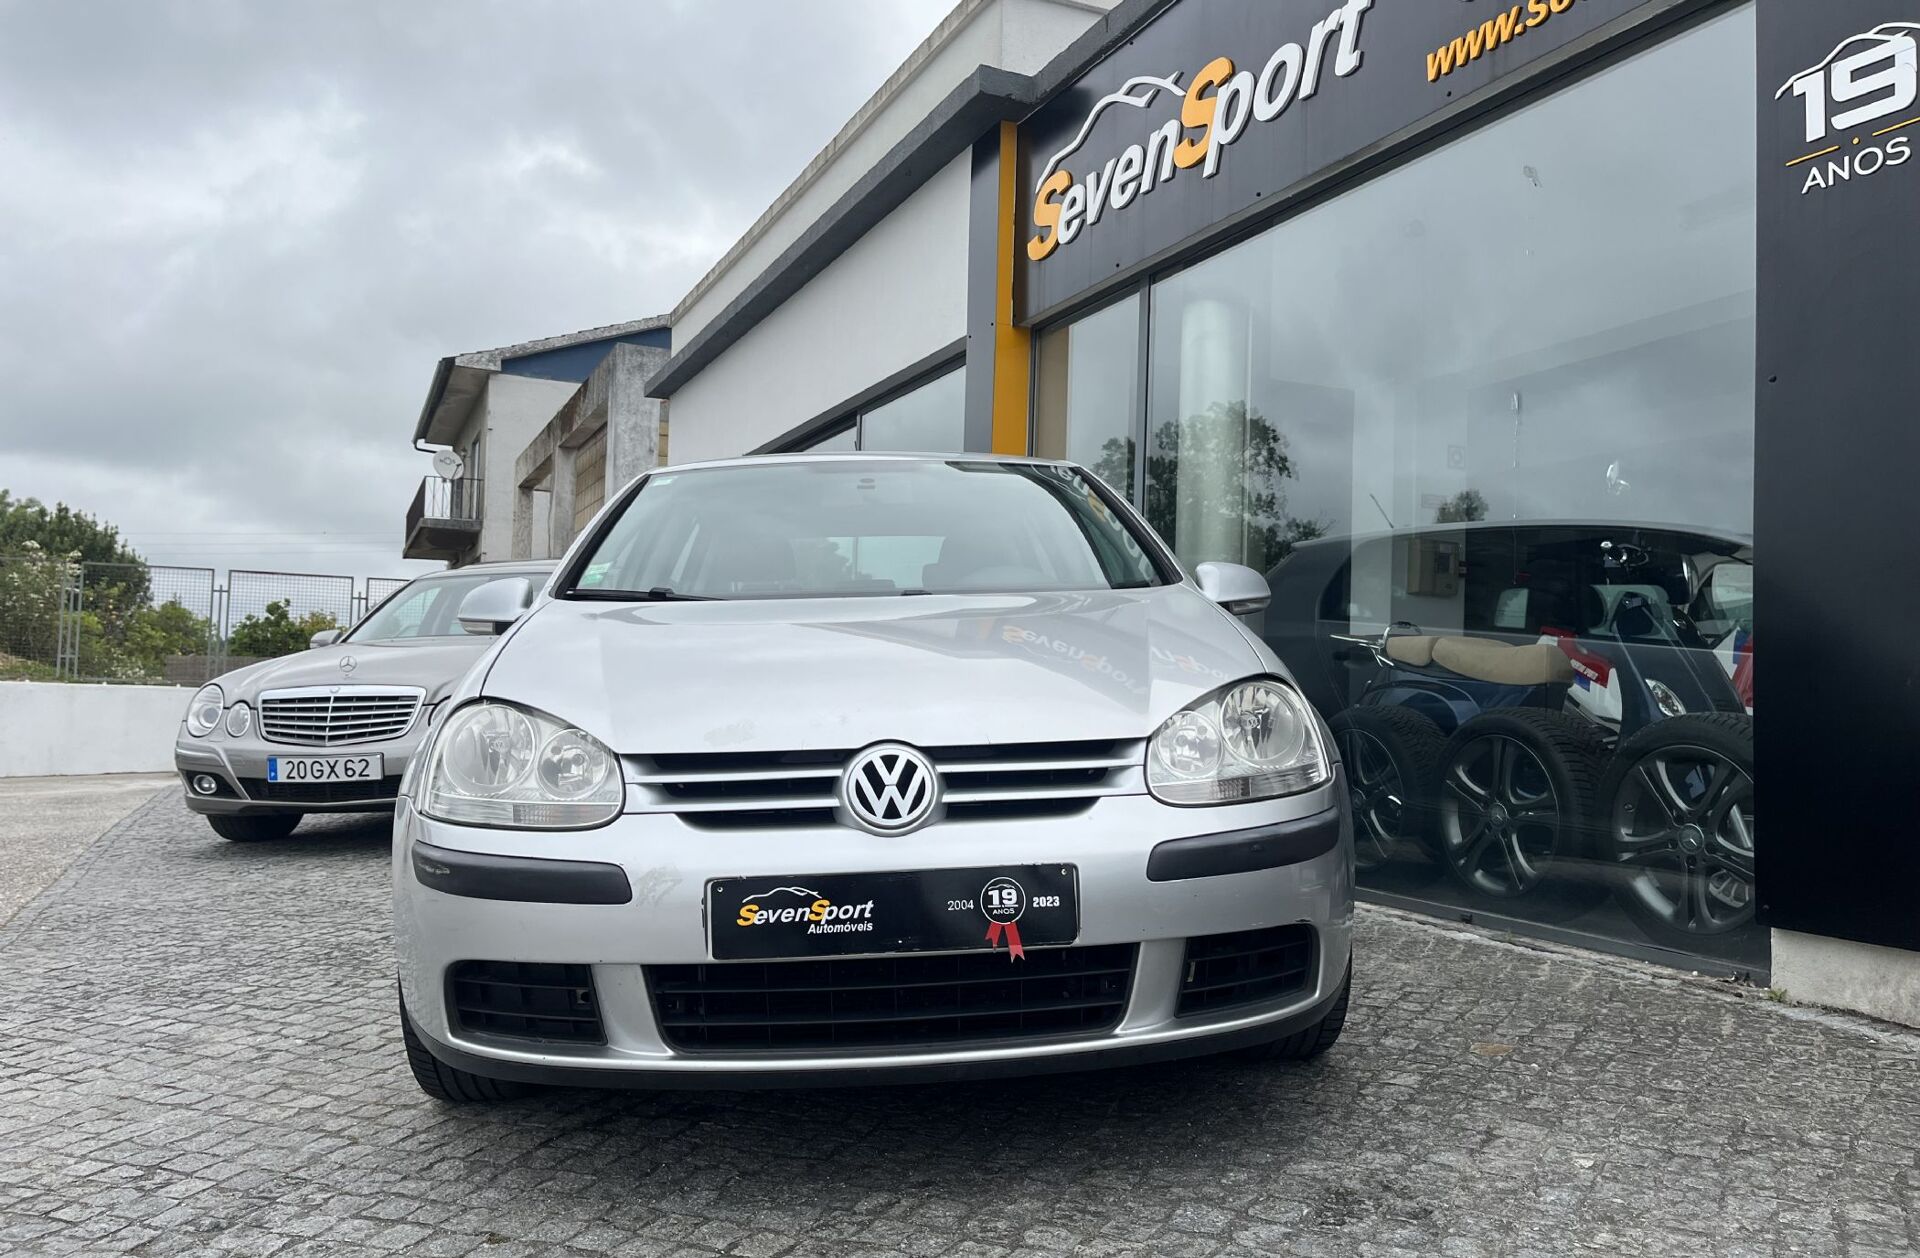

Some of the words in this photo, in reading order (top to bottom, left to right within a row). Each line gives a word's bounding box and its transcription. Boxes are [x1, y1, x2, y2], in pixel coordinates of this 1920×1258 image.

[1792, 35, 1918, 143] 19
[1027, 0, 1374, 262] SevenSport
[1801, 136, 1912, 194] ANOS
[947, 899, 975, 912] 2004
[987, 888, 1018, 906] 19
[1032, 896, 1060, 908] 2023
[736, 899, 874, 926] SevenSport
[807, 921, 874, 935] Automóveis
